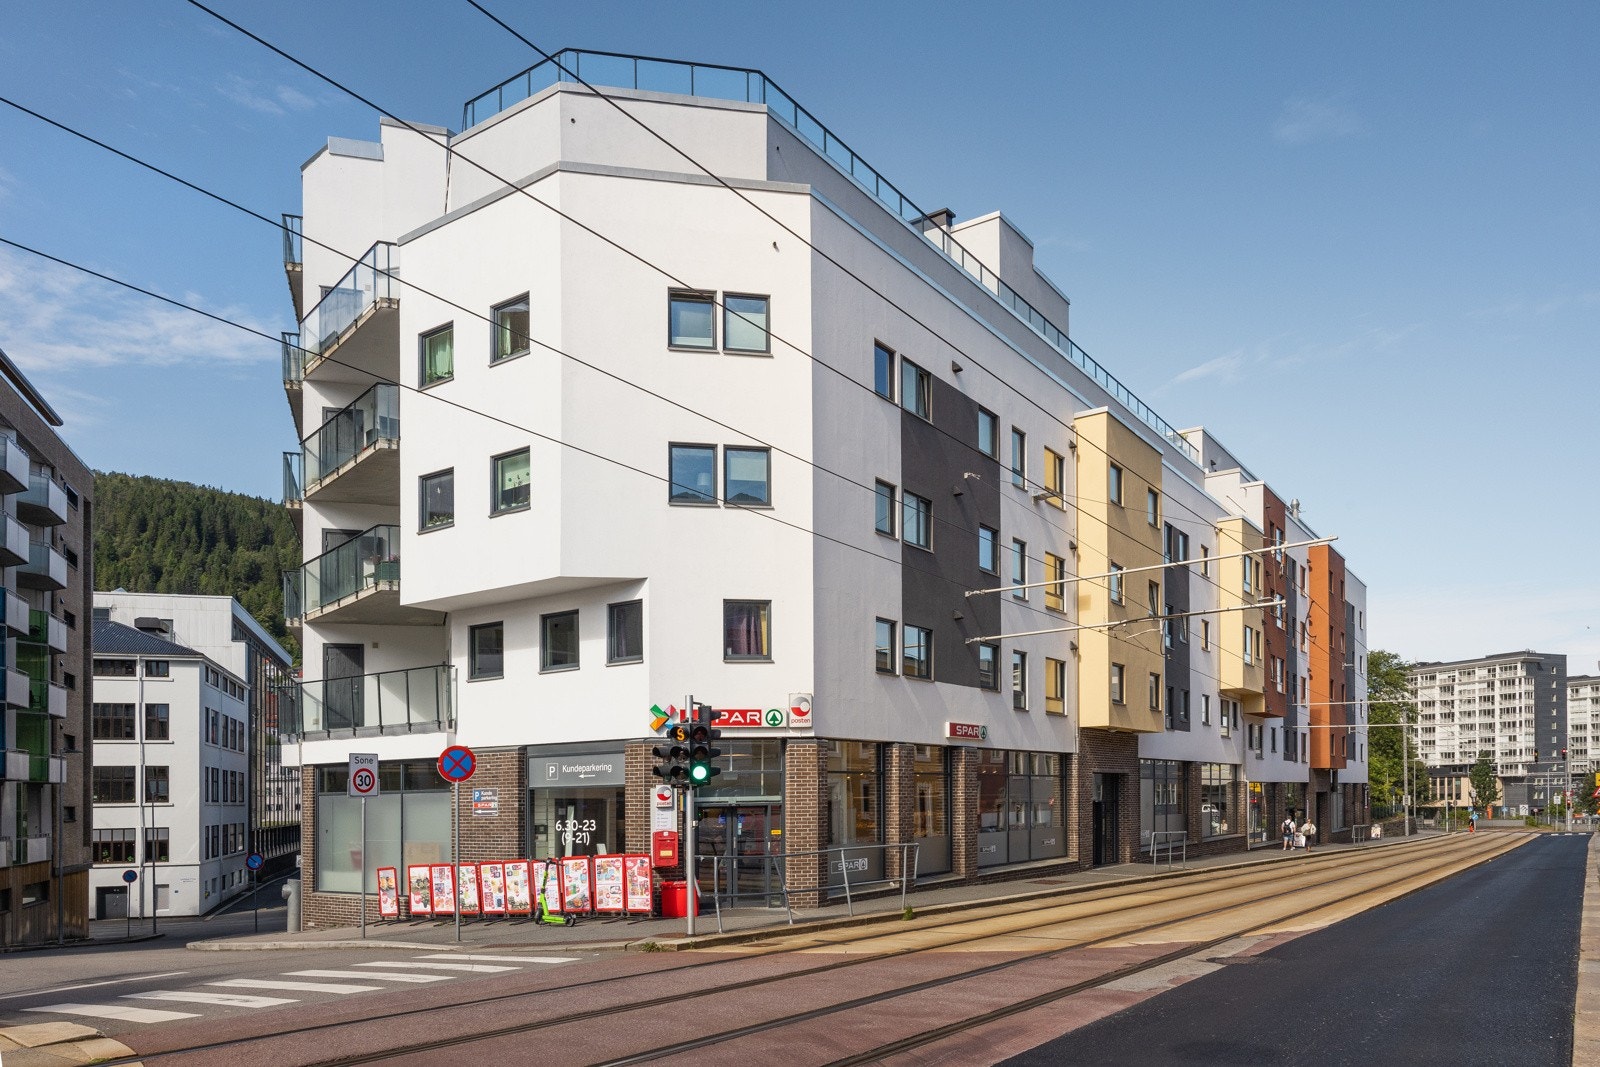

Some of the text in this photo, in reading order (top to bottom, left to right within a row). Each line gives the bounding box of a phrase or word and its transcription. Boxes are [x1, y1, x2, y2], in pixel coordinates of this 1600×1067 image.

[790, 717, 811, 725] posten
[956, 725, 979, 736] SPAR
[354, 756, 374, 764] Sone
[549, 764, 613, 777] P Kundeparkering
[357, 775, 372, 787] 30
[555, 820, 597, 831] 6.30-23
[561, 832, 590, 846] (9-21)
